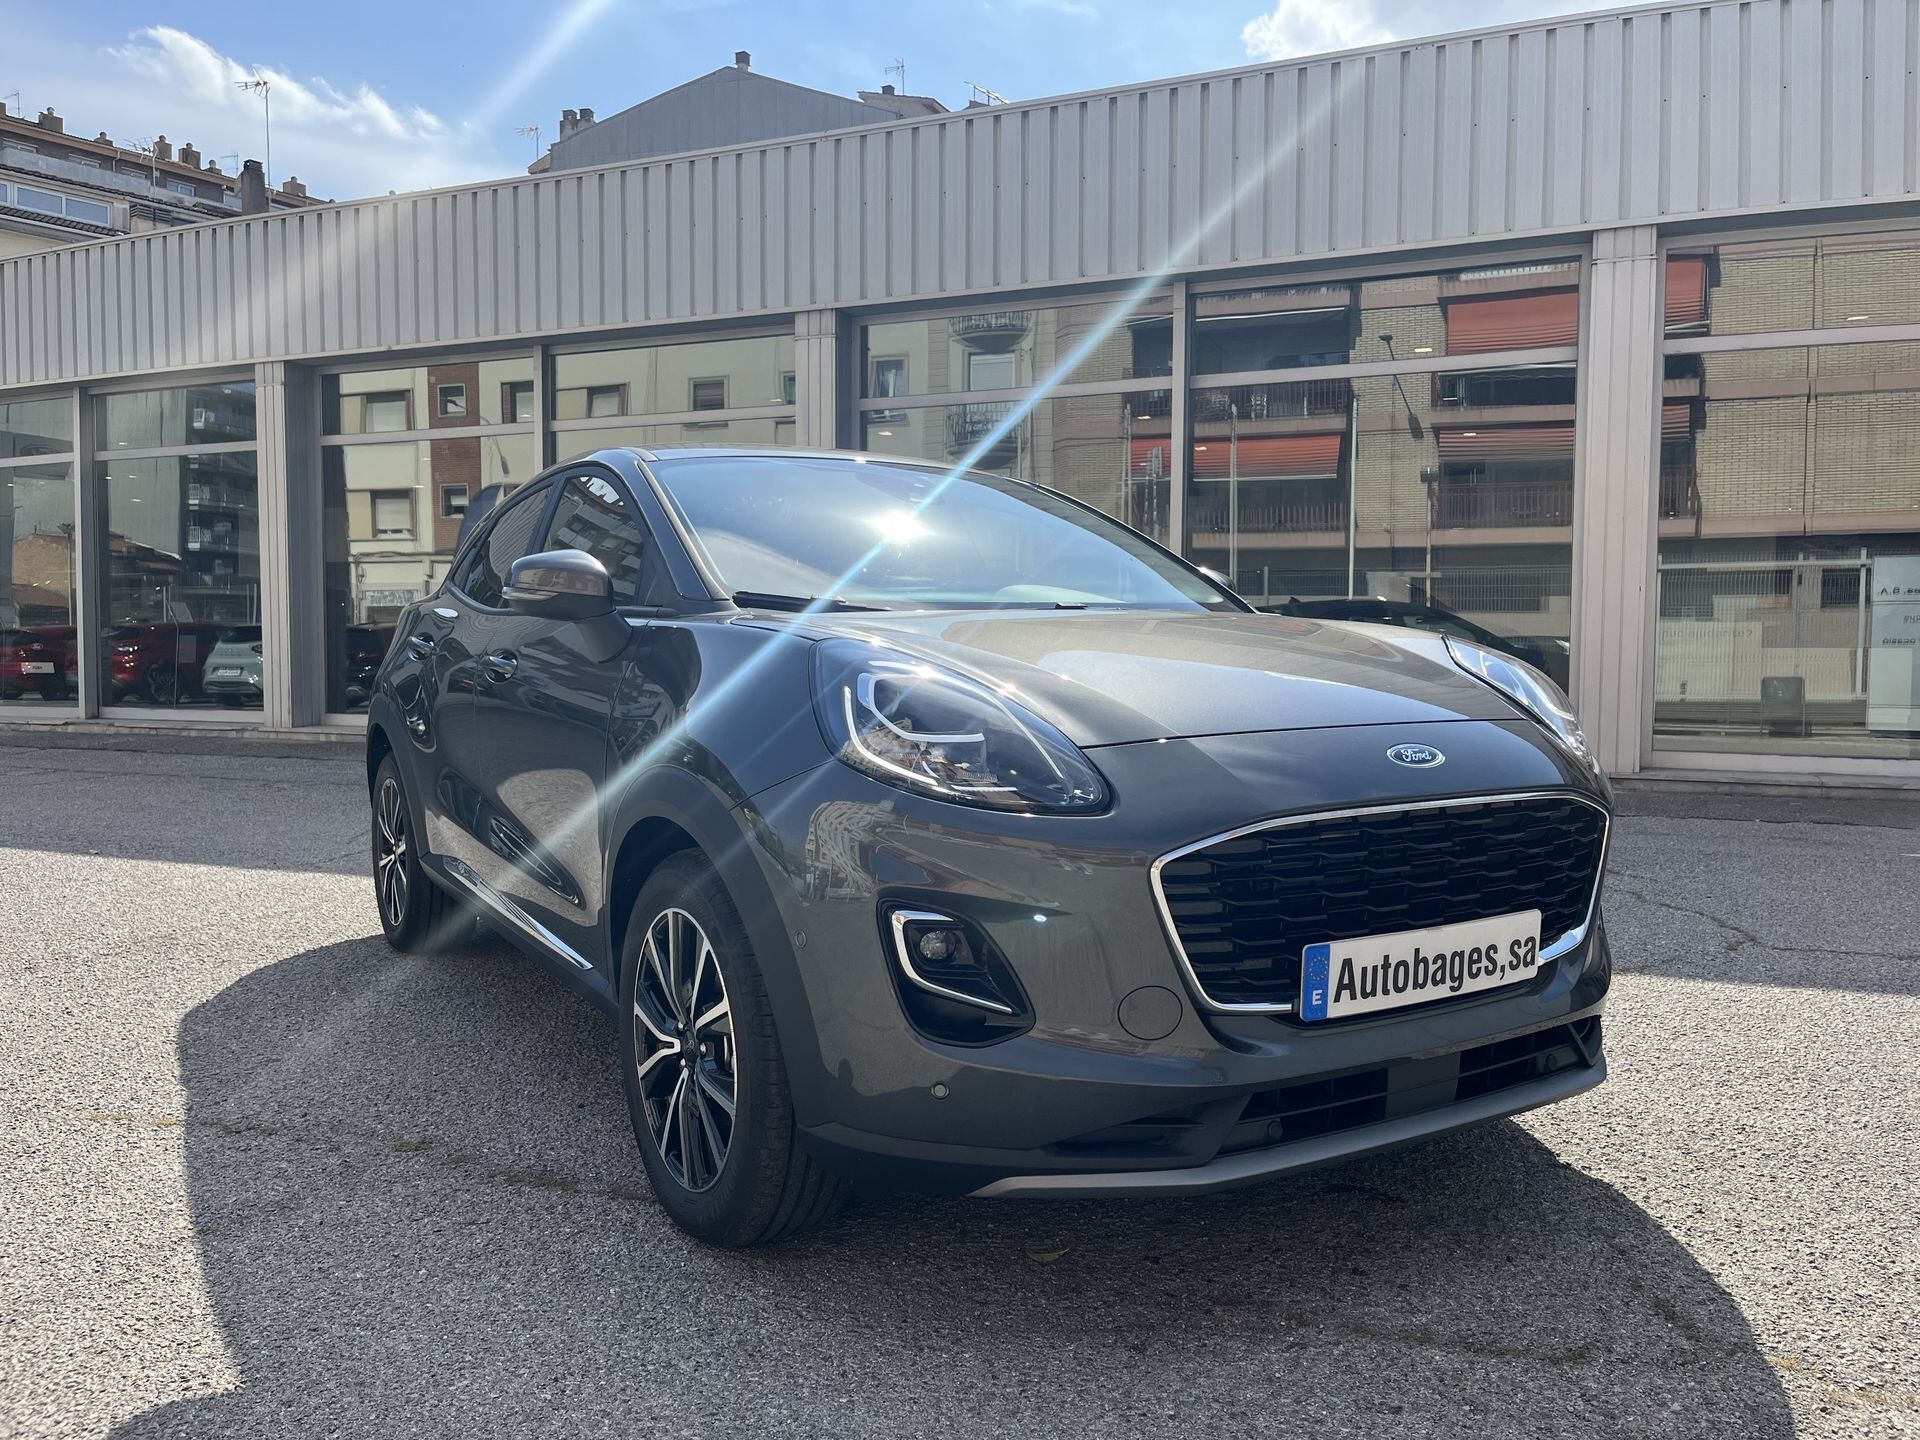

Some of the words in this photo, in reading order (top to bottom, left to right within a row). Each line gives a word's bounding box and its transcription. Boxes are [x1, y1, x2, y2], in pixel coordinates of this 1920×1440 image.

[1401, 748, 1432, 762] Ford
[1333, 936, 1537, 1004] Autobages,sa
[1312, 989, 1322, 1005] E
